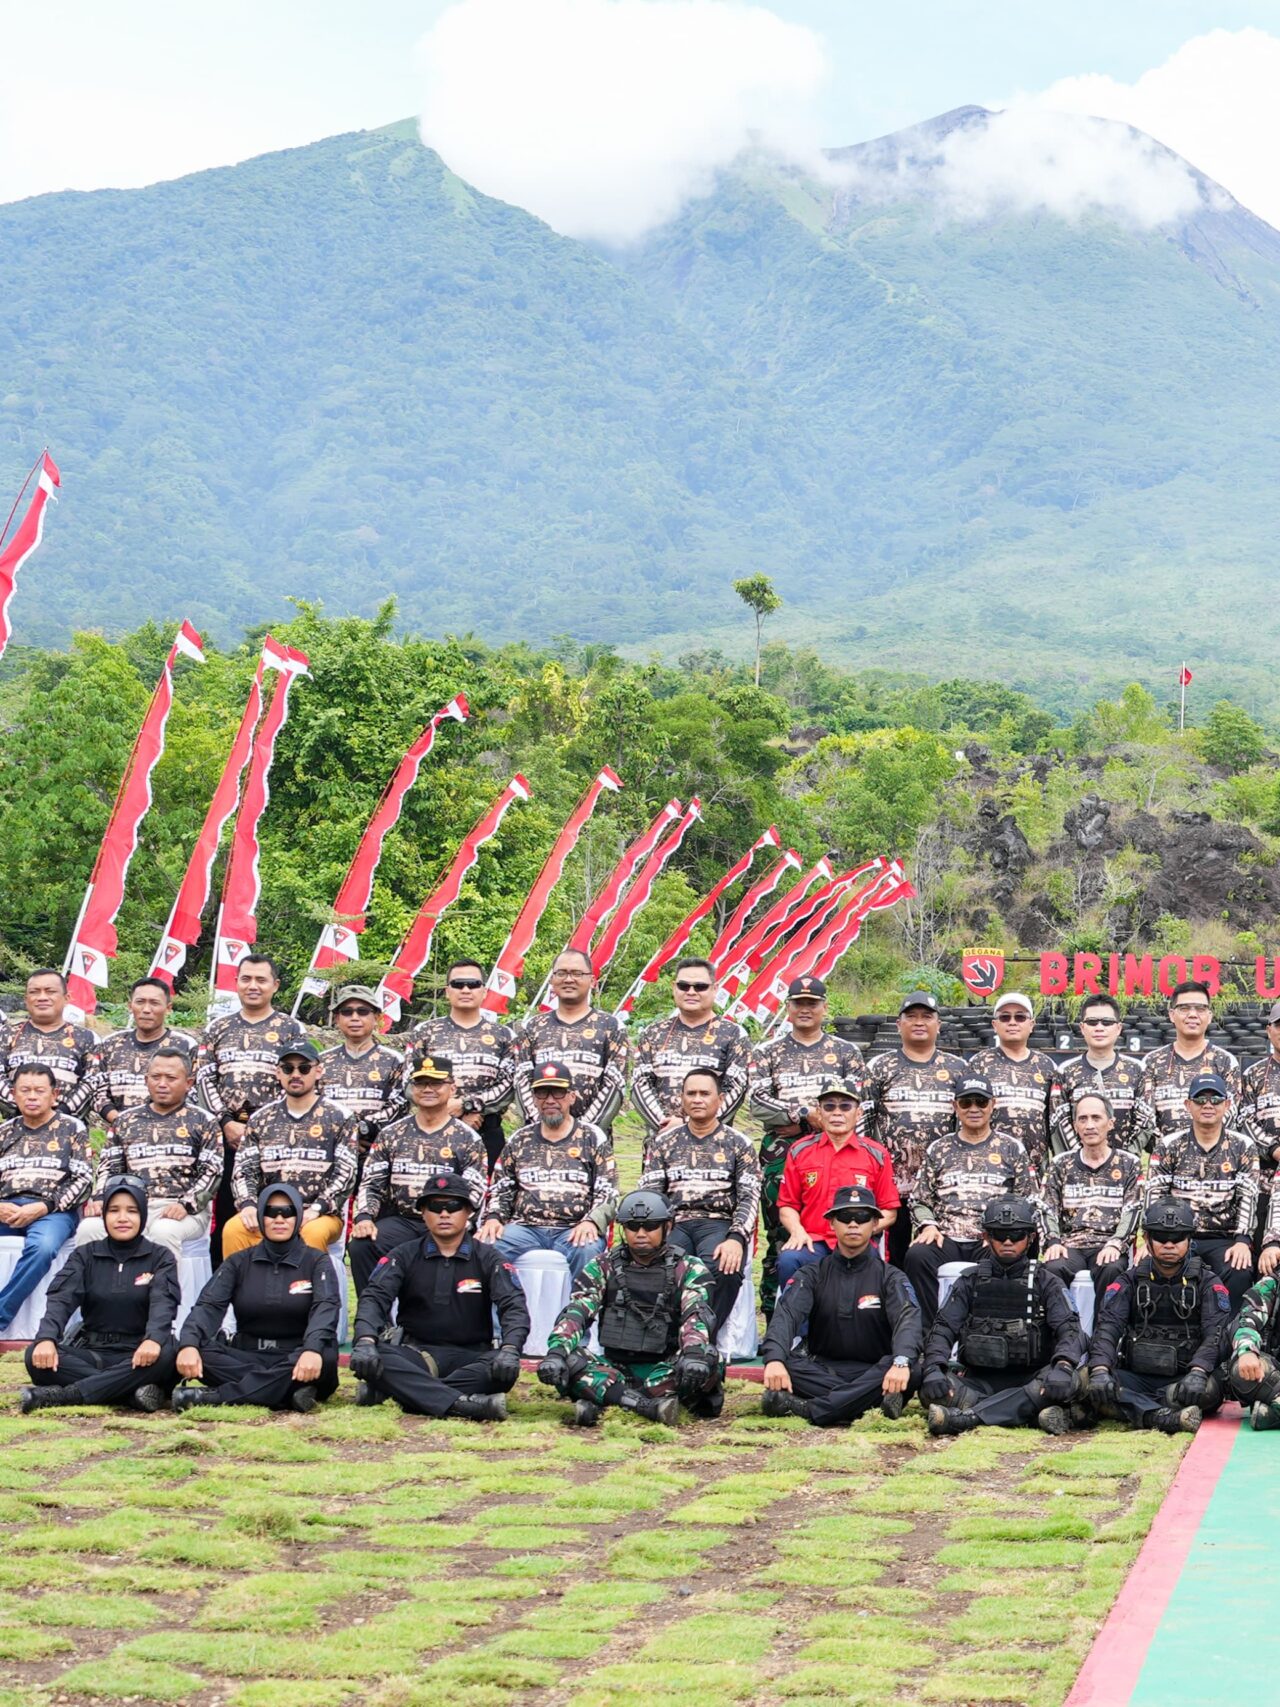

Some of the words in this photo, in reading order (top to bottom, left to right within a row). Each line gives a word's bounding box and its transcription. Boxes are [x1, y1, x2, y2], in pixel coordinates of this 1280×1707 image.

[1040, 951, 1221, 997] BRIMOB
[1060, 1036, 1070, 1050] 2
[1130, 1037, 1140, 1051] 3
[654, 1053, 720, 1069] SHOOTER
[324, 1087, 383, 1099] SHOOTER
[888, 1089, 956, 1101] SHOOTER
[992, 1086, 1047, 1100] HOOTER
[127, 1144, 192, 1159] SHOOTER
[263, 1147, 327, 1160] SHOOTER
[519, 1168, 588, 1182] SHOOTER
[667, 1169, 730, 1181] SHOOTER
[942, 1173, 1006, 1187] SHOOTER
[1064, 1185, 1124, 1198] SHOOTER
